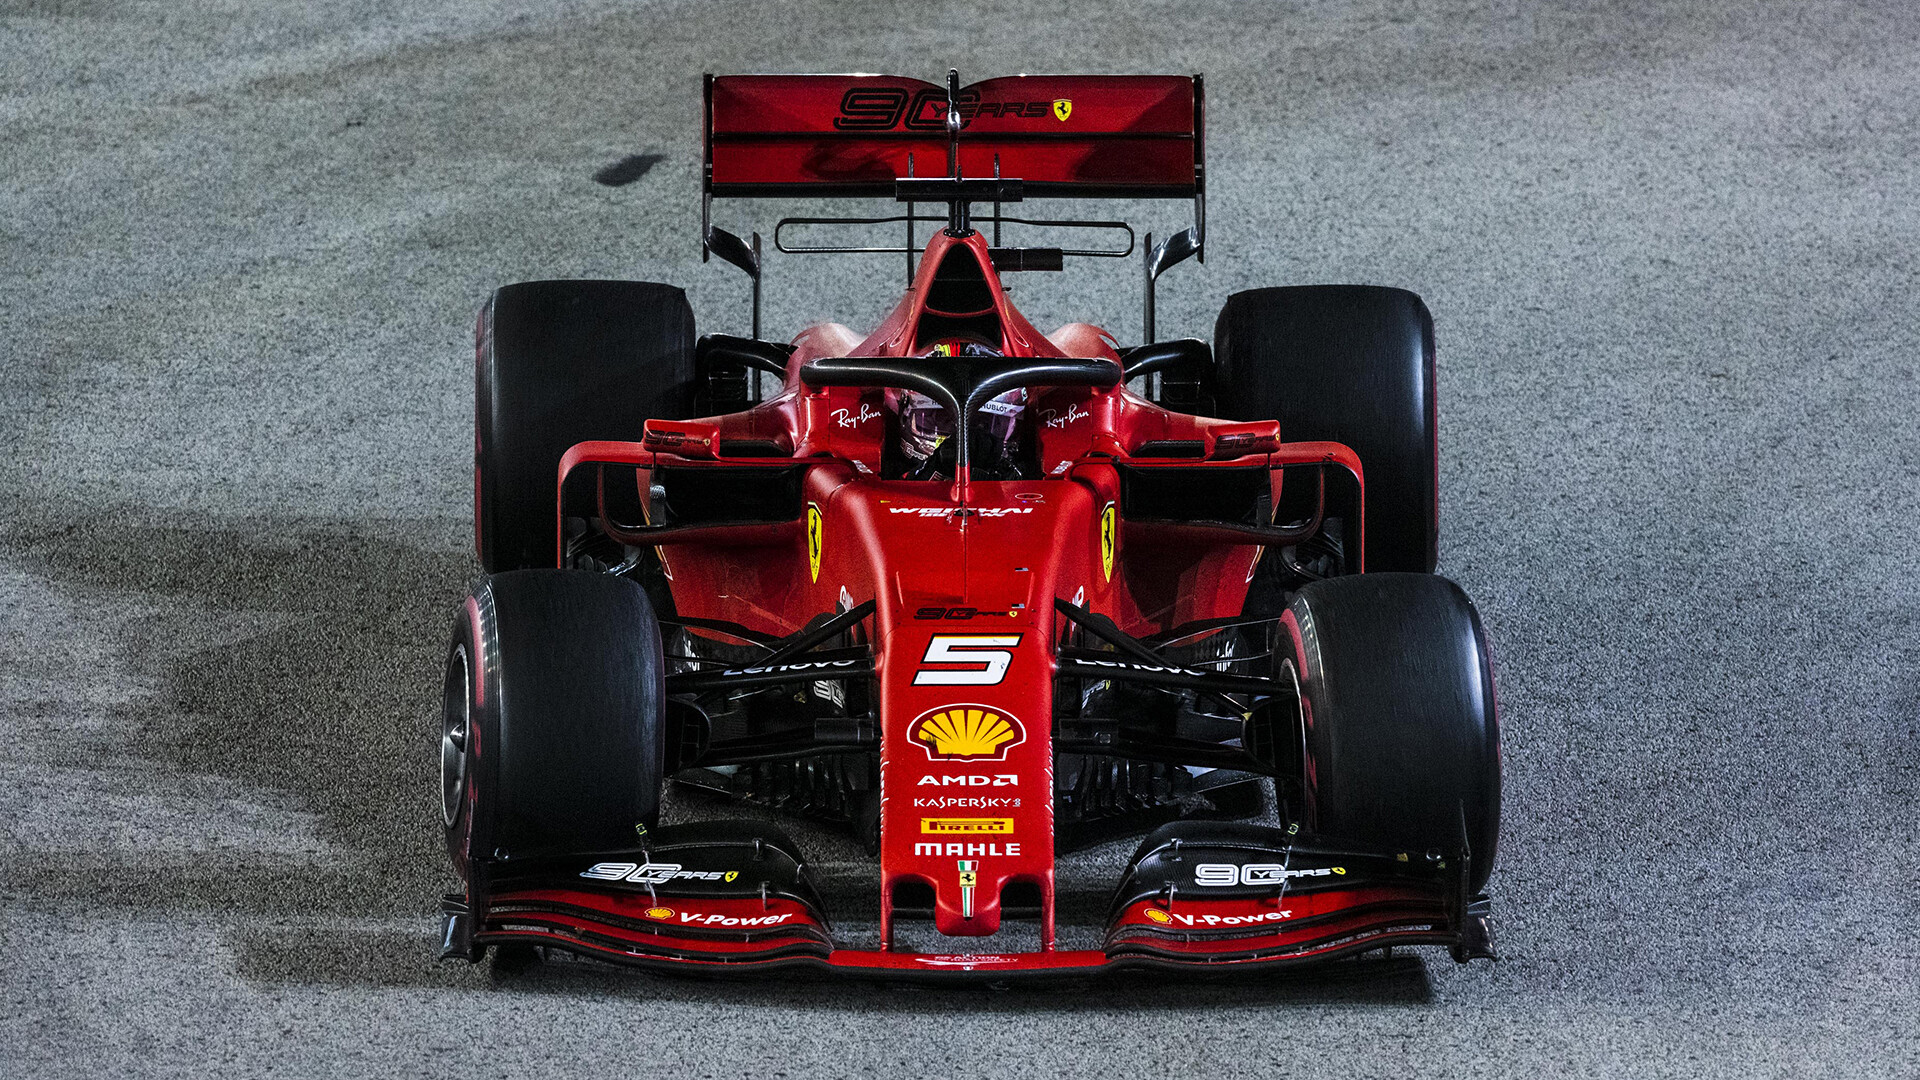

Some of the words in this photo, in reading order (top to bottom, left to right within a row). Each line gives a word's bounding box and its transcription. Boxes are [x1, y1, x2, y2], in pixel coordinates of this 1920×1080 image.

[833, 87, 981, 131] 90
[913, 607, 978, 621] 90
[910, 632, 1025, 687] 5
[916, 774, 992, 786] AMD
[913, 796, 1012, 809] KASPERSKY
[914, 842, 1021, 857] MAHLE
[580, 862, 682, 884] 90
[646, 869, 724, 881] YEARS
[1194, 863, 1286, 886] 90
[1253, 868, 1331, 878] YEARS
[680, 911, 793, 927] V-Power
[1173, 910, 1293, 926] V-Power
